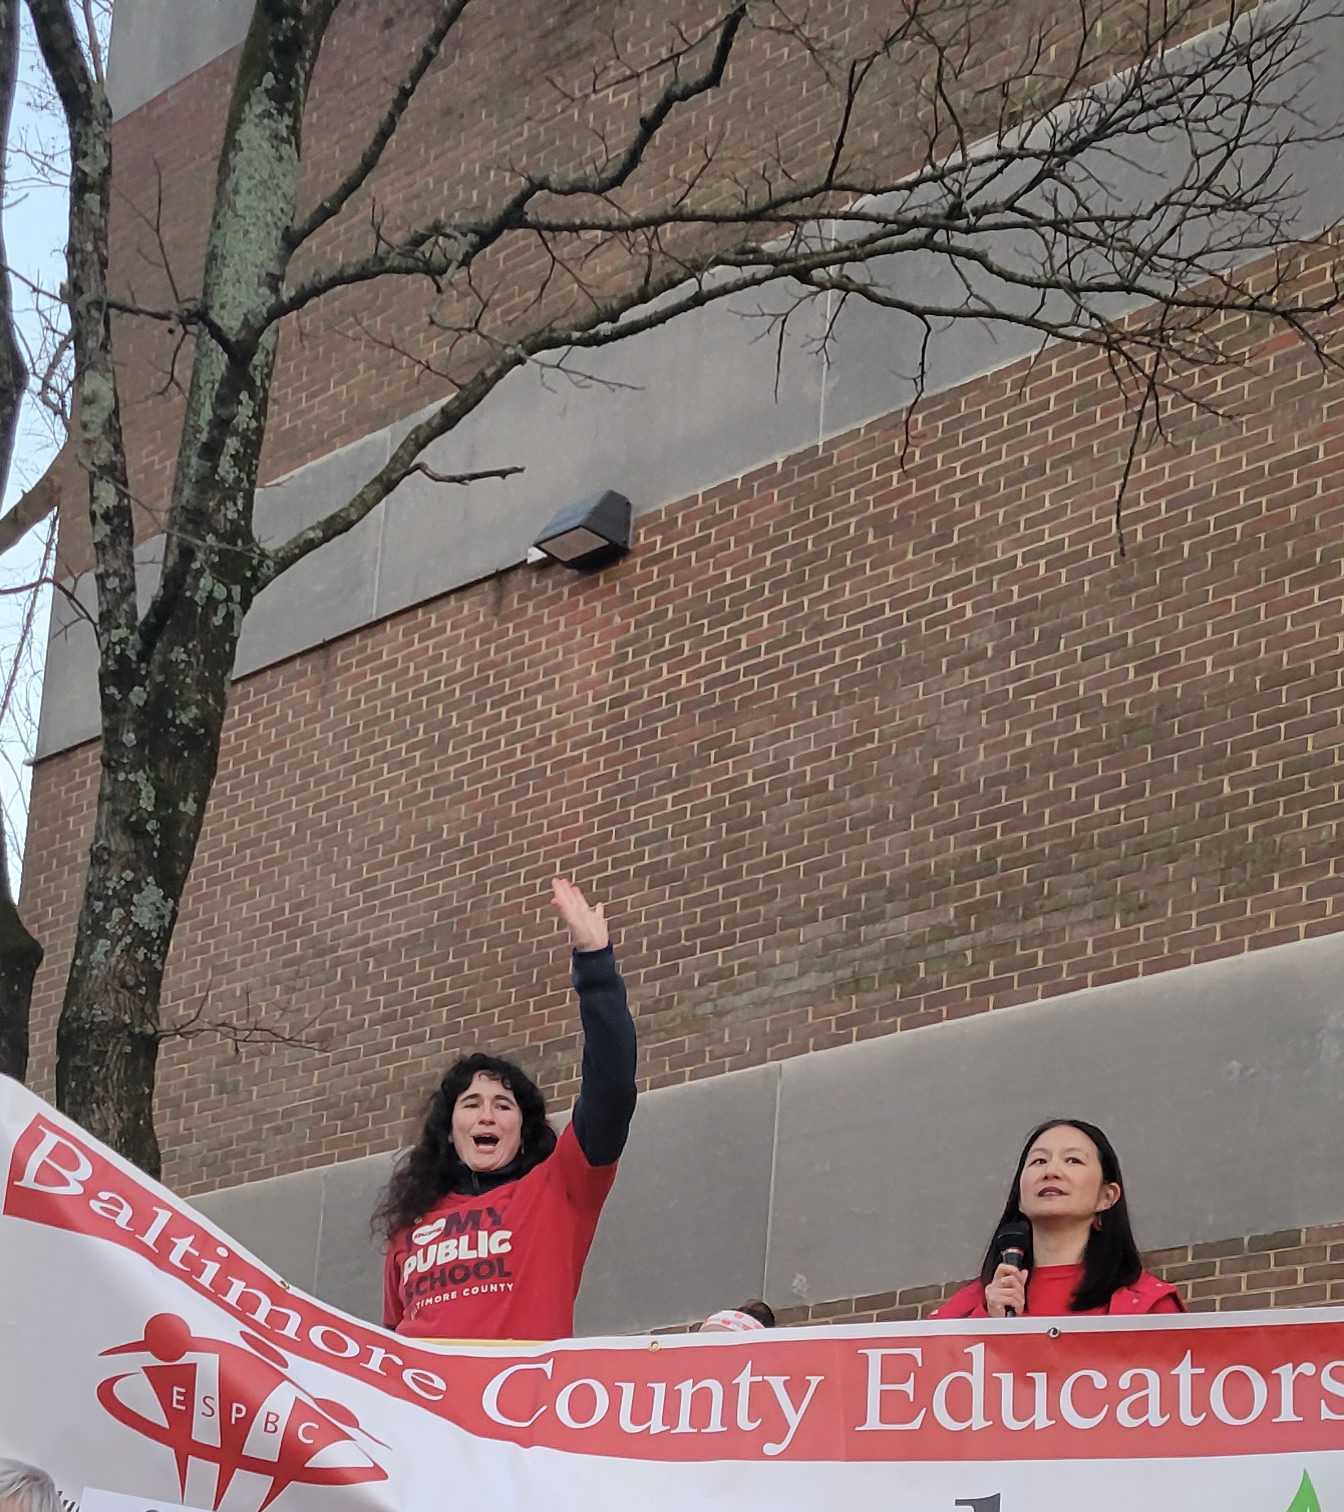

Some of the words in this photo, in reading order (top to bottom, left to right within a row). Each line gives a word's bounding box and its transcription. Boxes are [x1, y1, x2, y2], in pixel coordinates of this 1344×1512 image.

[403, 1230, 513, 1286] PUBLIC
[13, 1122, 447, 1402] Baltimore
[482, 1356, 825, 1456] County
[462, 1283, 514, 1298] COUNTY
